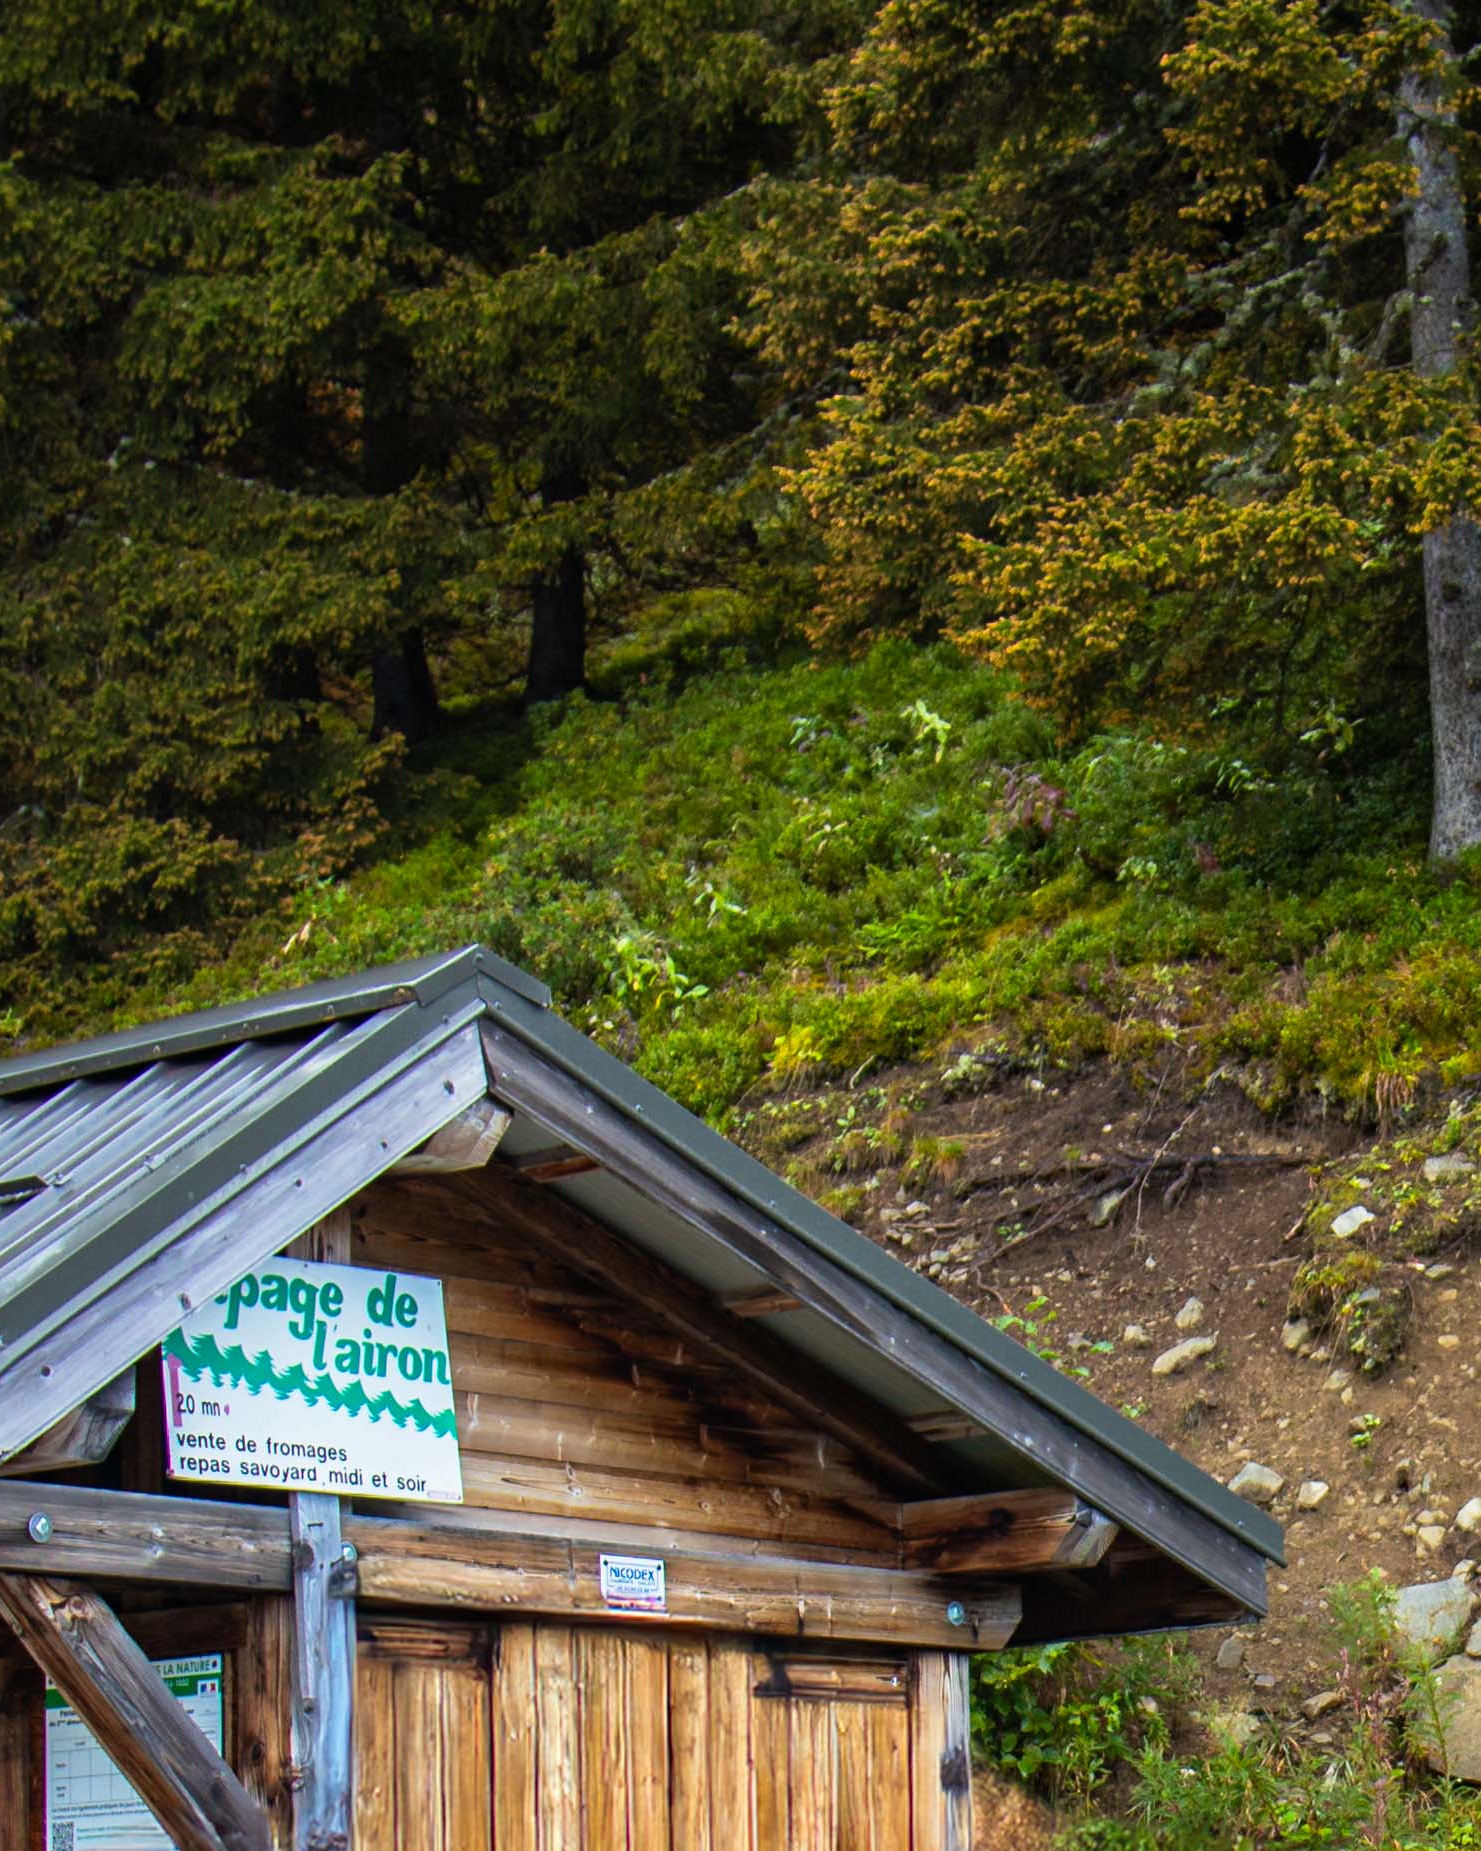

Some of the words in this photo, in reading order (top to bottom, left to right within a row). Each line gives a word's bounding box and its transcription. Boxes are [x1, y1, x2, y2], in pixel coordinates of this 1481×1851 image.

[215, 1273, 344, 1341] page
[367, 1273, 419, 1328] de
[313, 1320, 451, 1385] l'airon
[176, 1393, 196, 1415] 20
[202, 1400, 221, 1417] mn
[176, 1433, 227, 1450] vente
[236, 1435, 257, 1453] de
[267, 1437, 348, 1463] fromages
[180, 1456, 231, 1475] repas
[240, 1461, 317, 1483] savoyard
[329, 1467, 363, 1486] midi
[372, 1472, 388, 1488] et
[397, 1475, 427, 1492] soir
[610, 1567, 655, 1581] NICODEX
[163, 1663, 174, 1675] LA
[176, 1659, 211, 1673] NATURE
